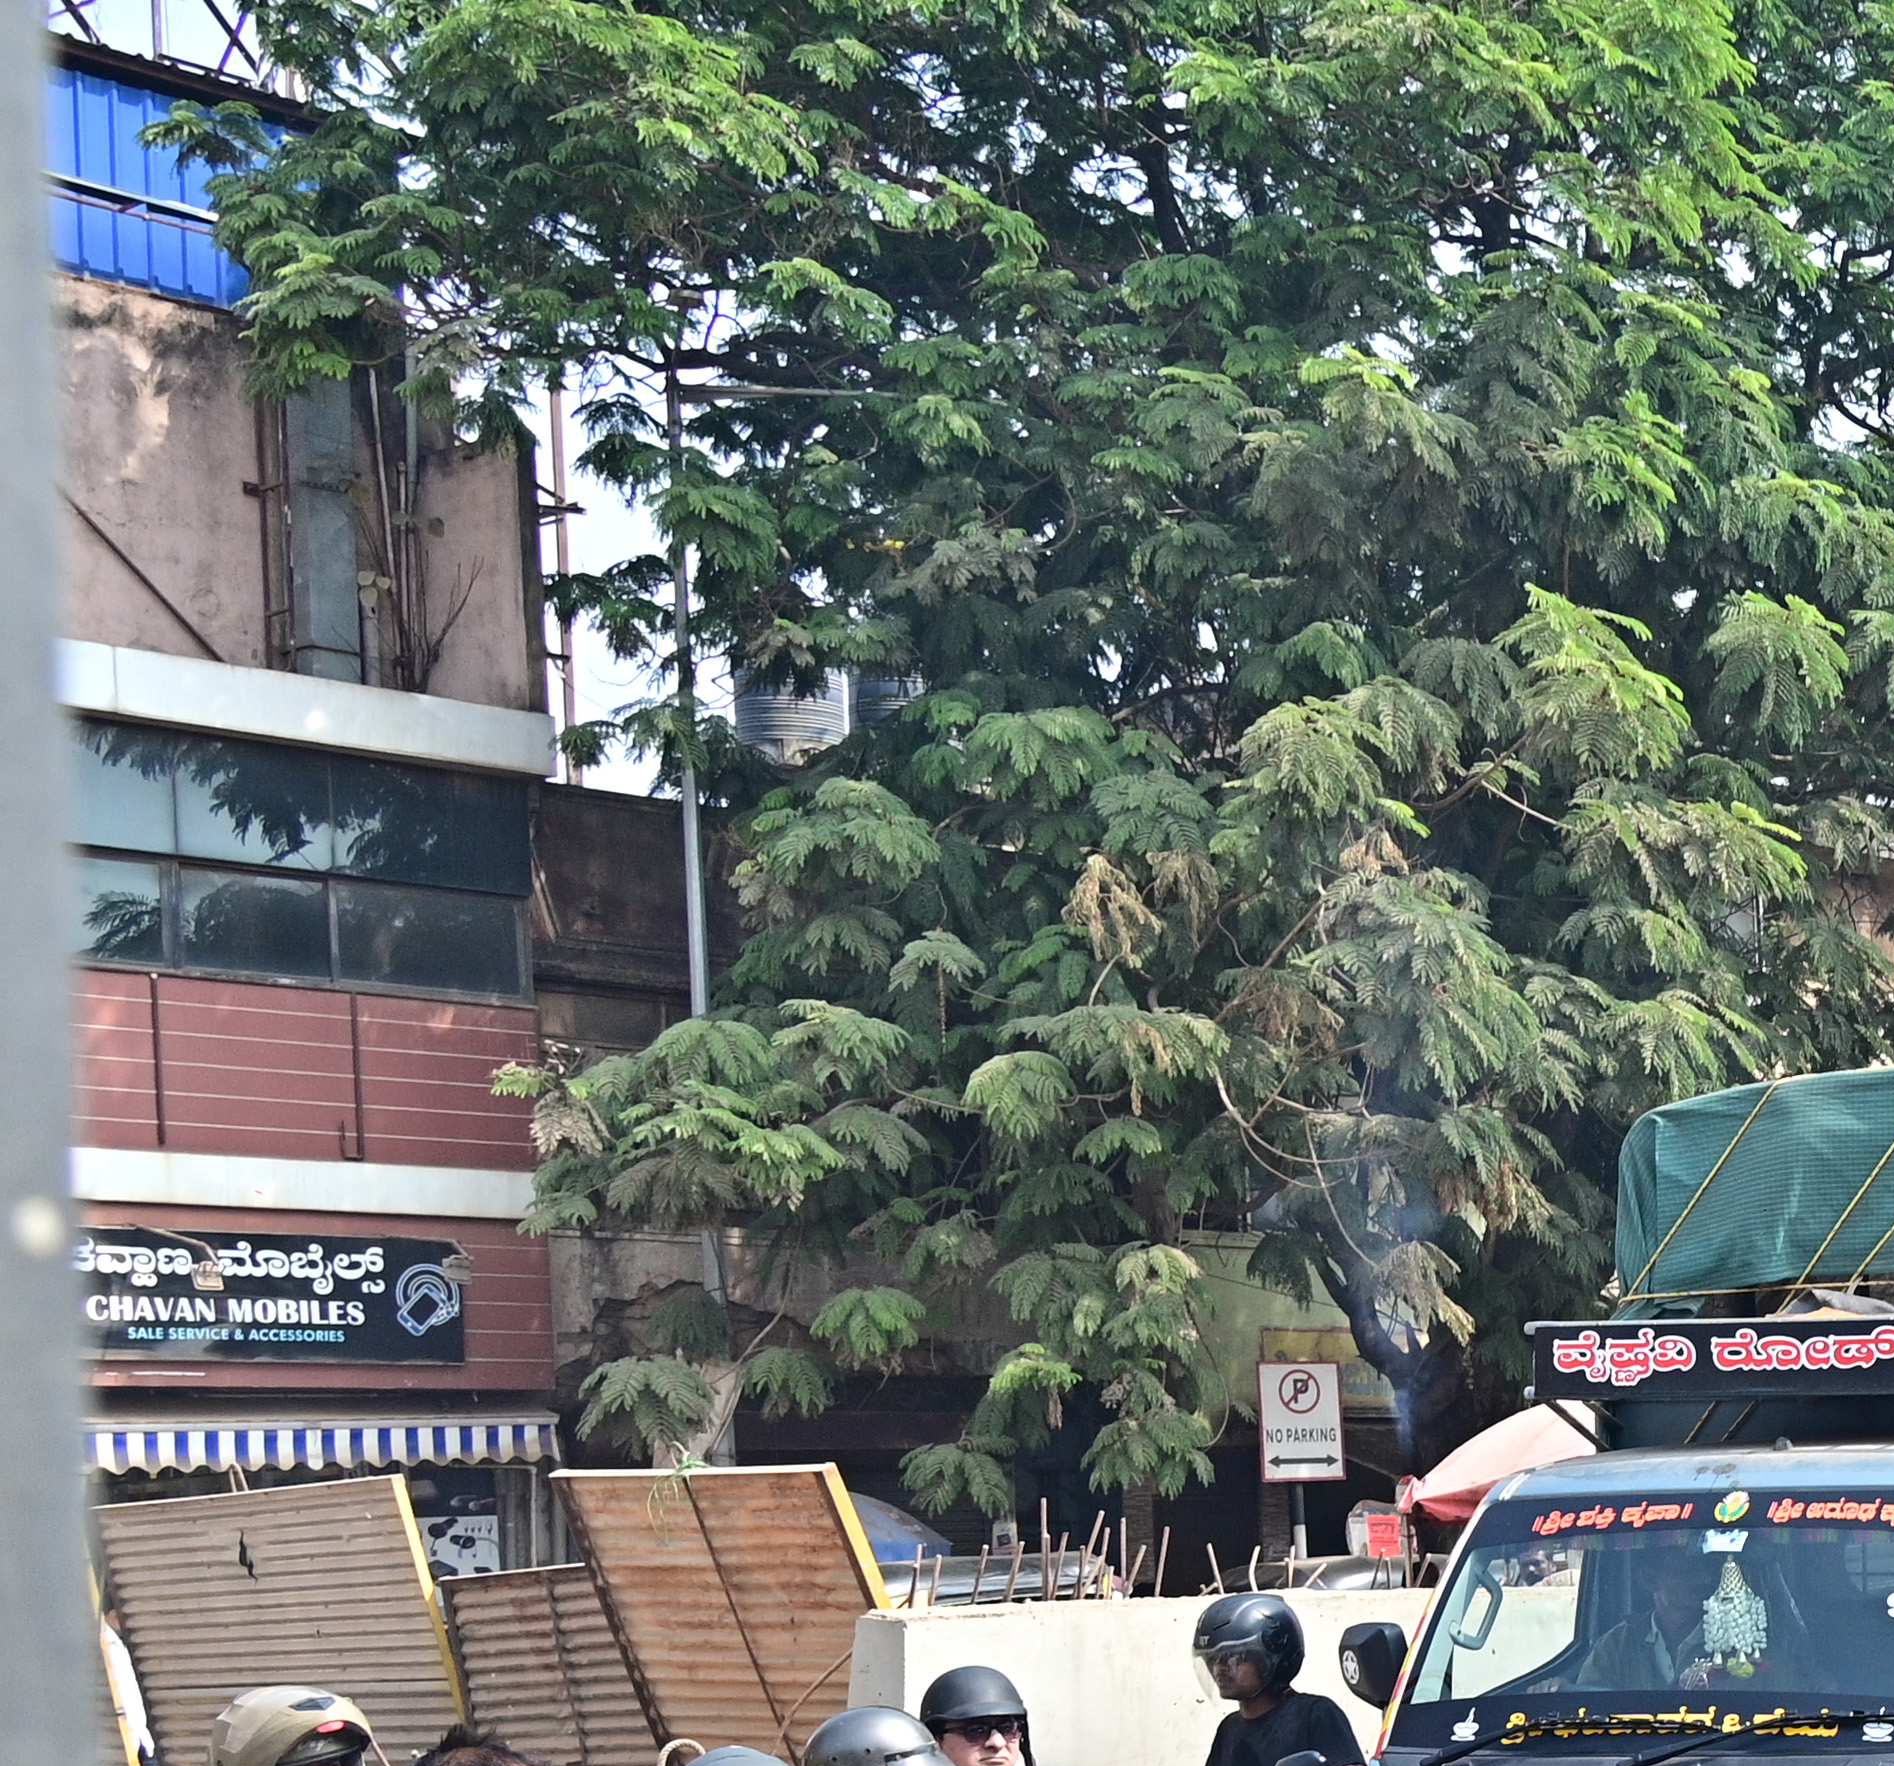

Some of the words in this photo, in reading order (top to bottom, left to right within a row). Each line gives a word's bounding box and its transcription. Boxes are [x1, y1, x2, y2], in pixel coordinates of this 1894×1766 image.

[86, 1296, 215, 1324] CHAVAN
[228, 1298, 365, 1326] MOBILES
[127, 1326, 164, 1341] SALE
[169, 1327, 229, 1341] SERVICE
[234, 1328, 244, 1341] &
[248, 1328, 346, 1343] ACCESSORIES
[1265, 1427, 1284, 1445] NO
[1286, 1426, 1337, 1444] PARKING
